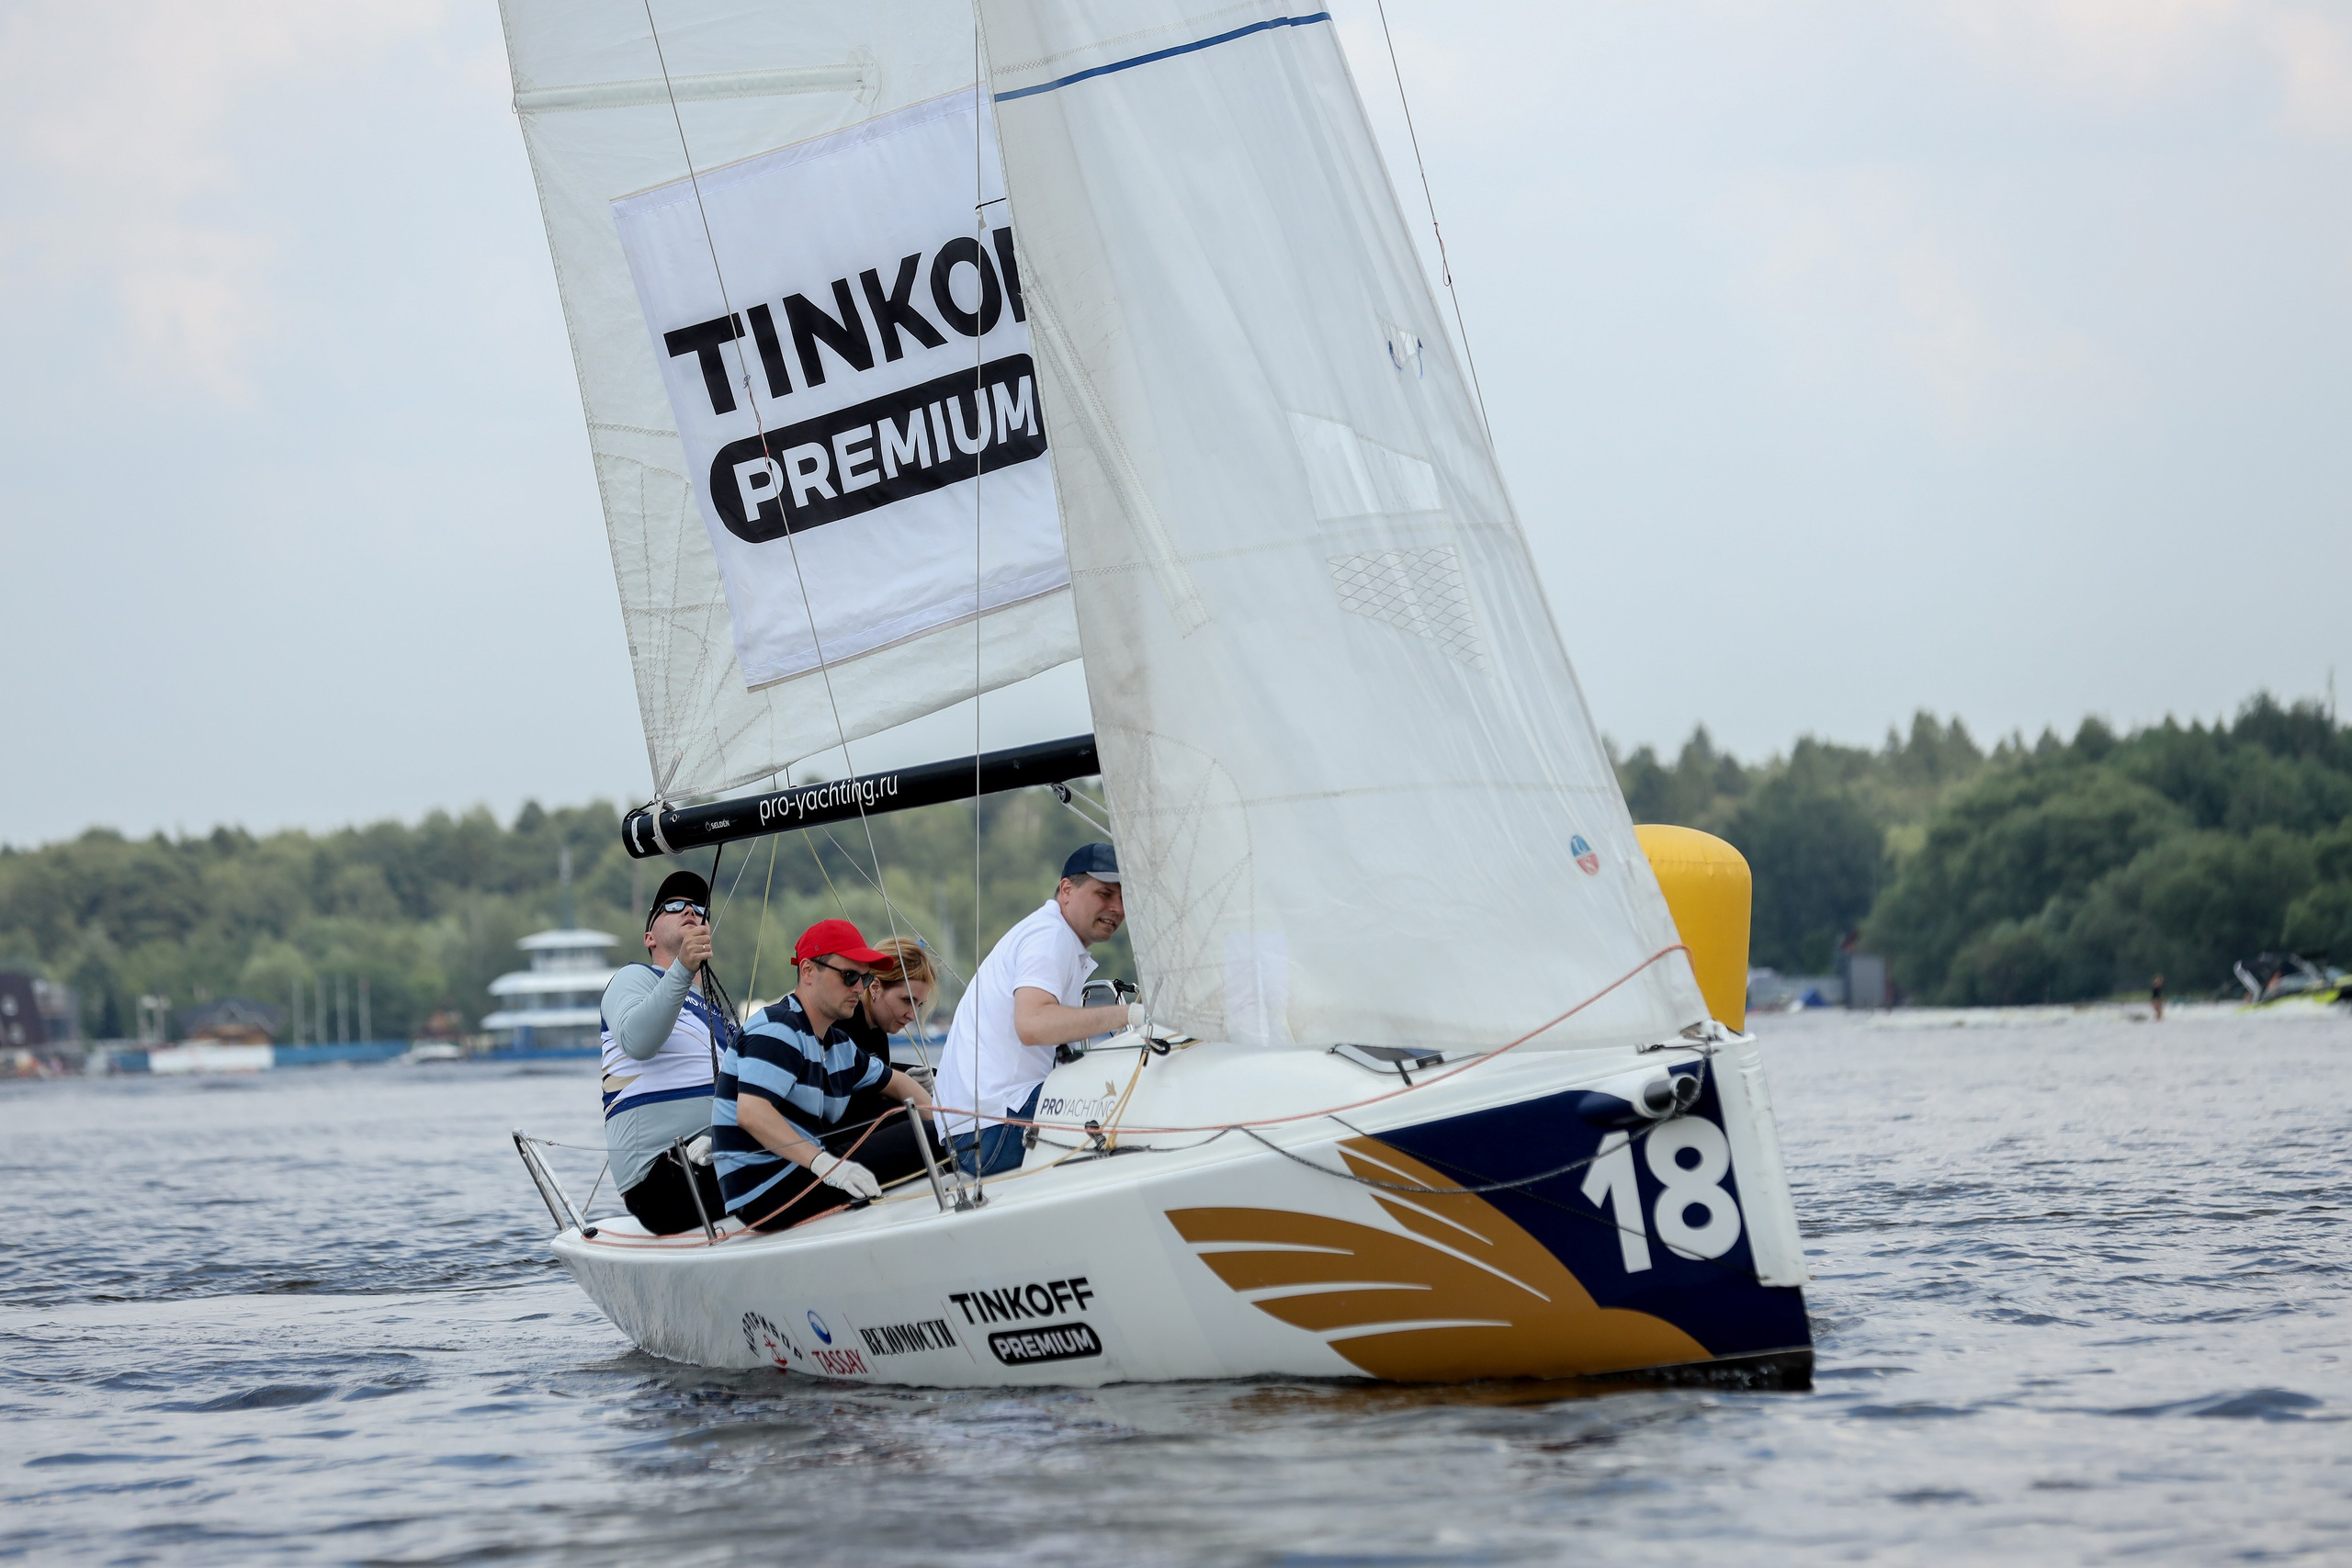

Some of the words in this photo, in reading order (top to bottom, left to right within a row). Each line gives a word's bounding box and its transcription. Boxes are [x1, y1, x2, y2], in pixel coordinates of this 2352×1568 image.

[732, 374, 1039, 523] PREMIUM
[759, 774, 899, 827] pro-yachting.ru
[1040, 1098, 1115, 1119] PROYACHTING
[1580, 1114, 1742, 1274] 18
[948, 1277, 1095, 1325] TINKOFF
[858, 1319, 958, 1359] ВЕДОМОСТИ
[993, 1328, 1096, 1360] PREMIUM
[810, 1348, 869, 1375] TASSAY
